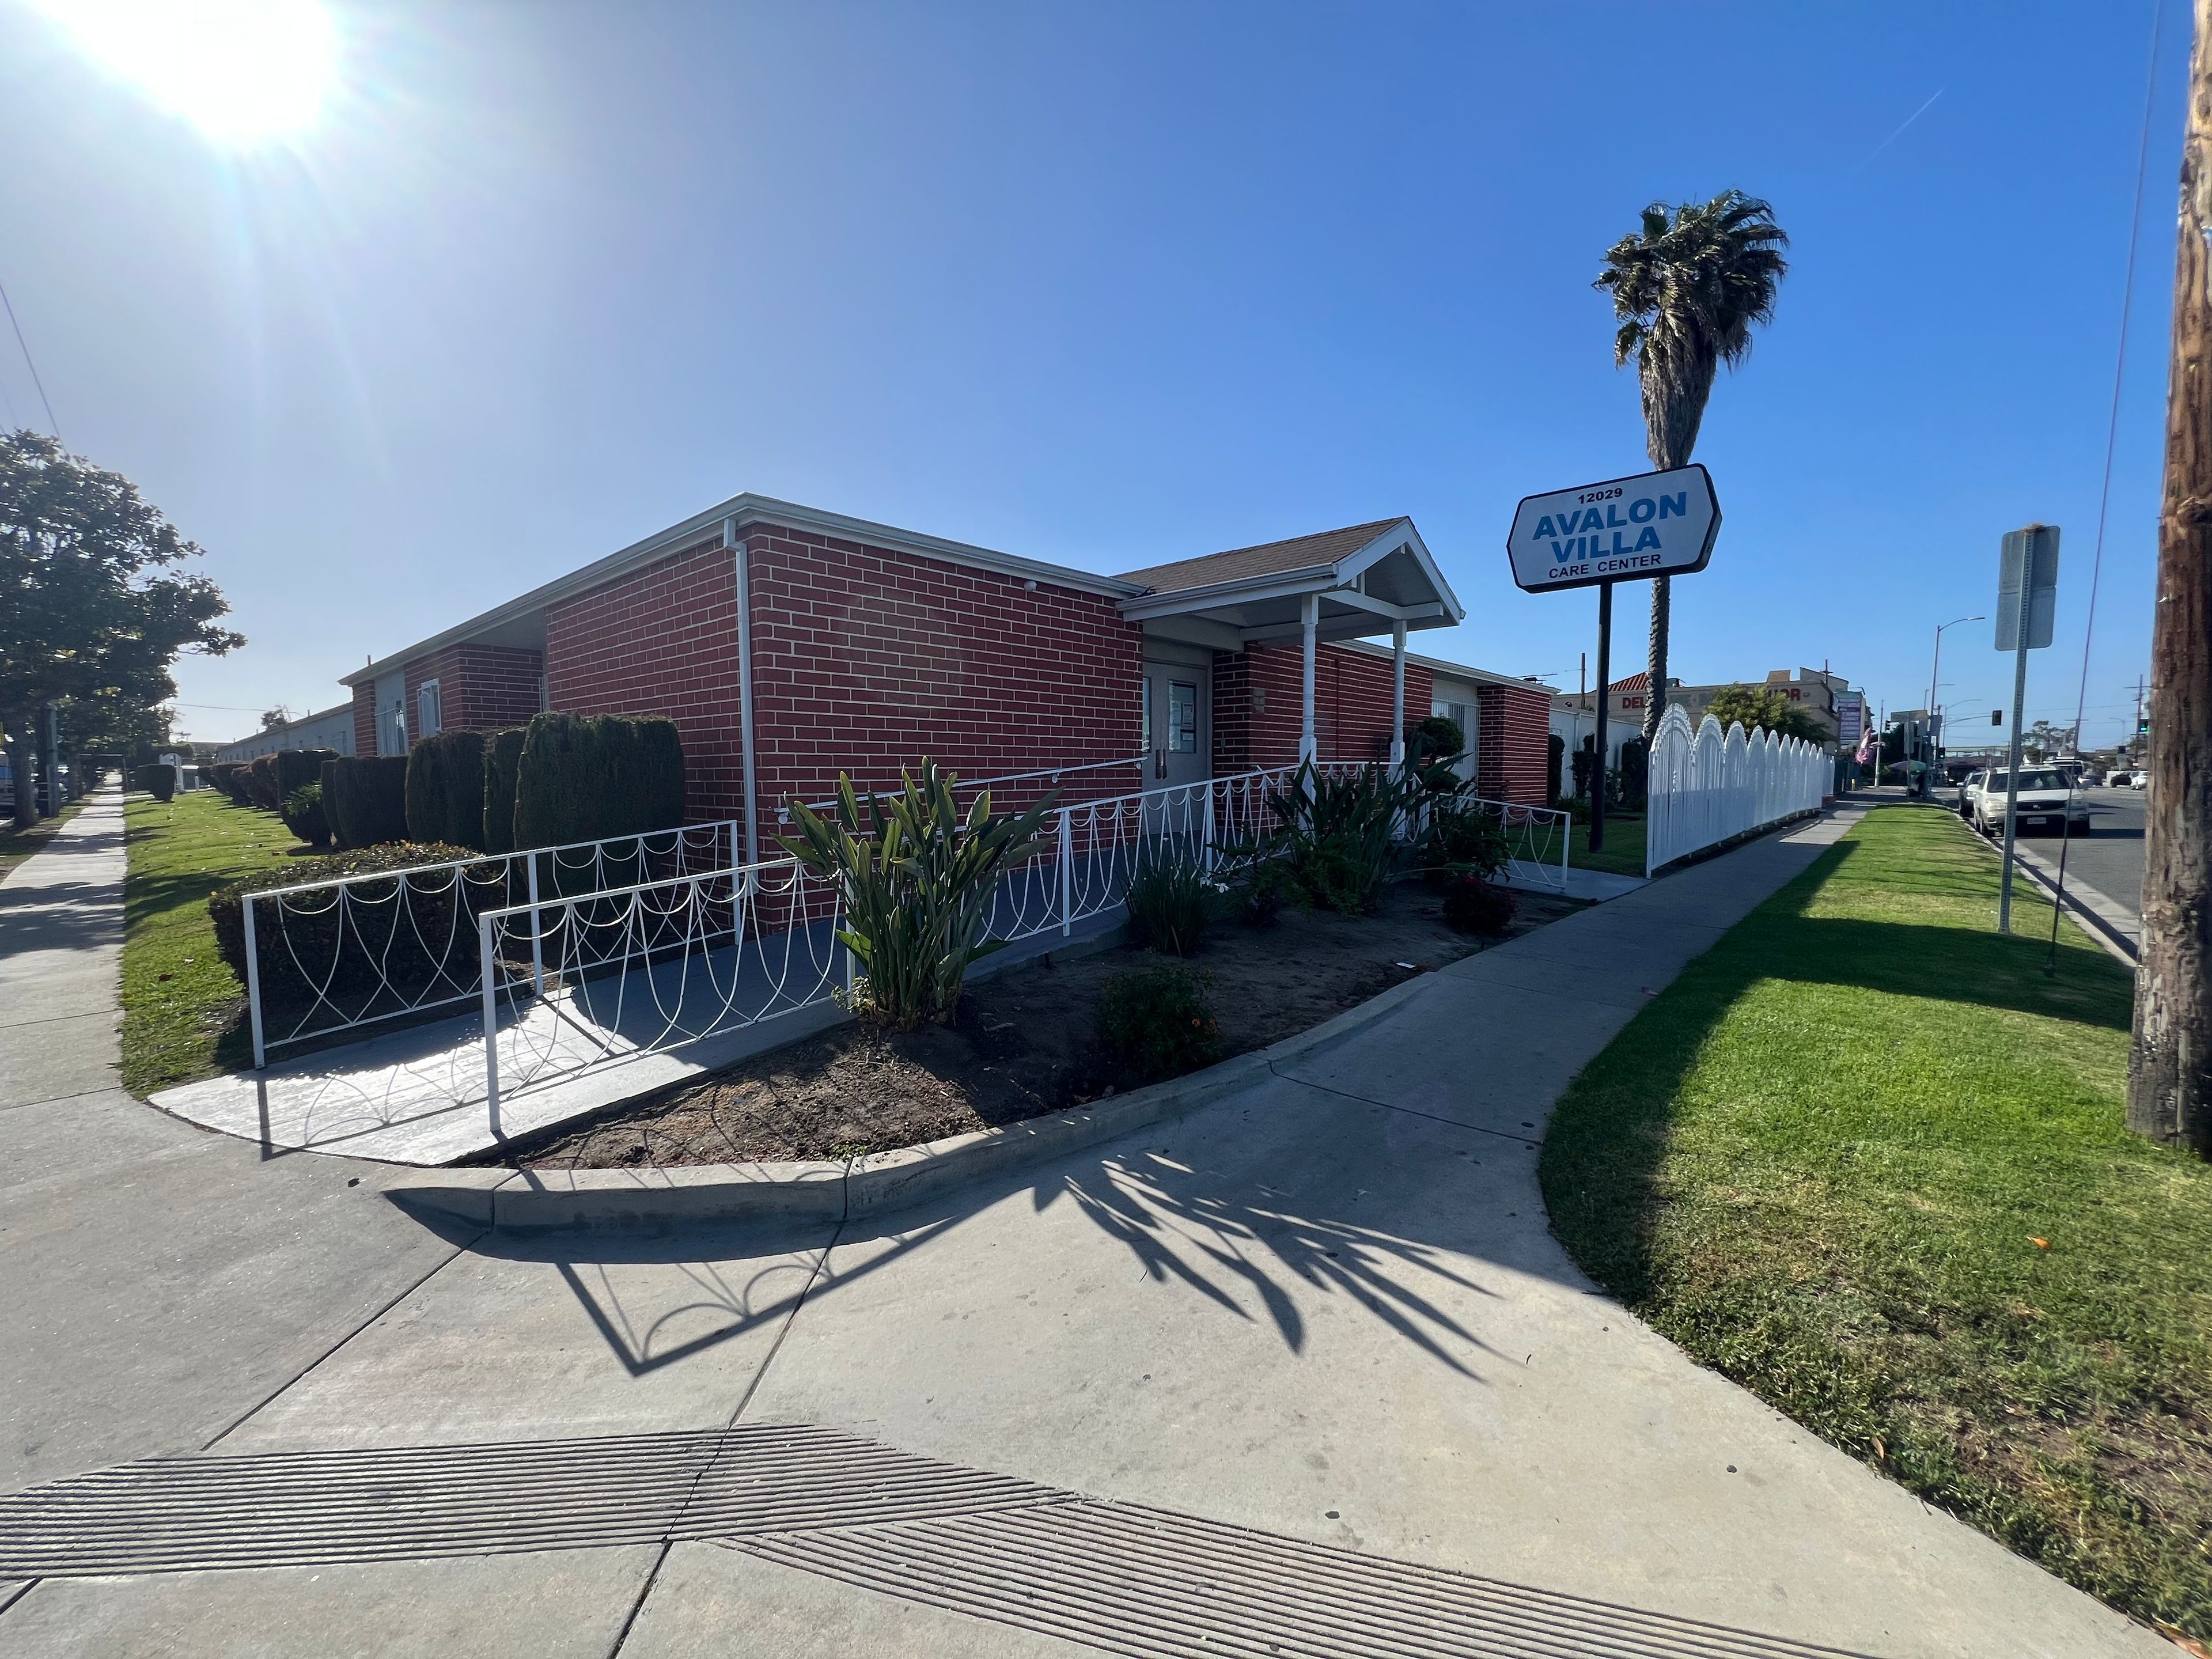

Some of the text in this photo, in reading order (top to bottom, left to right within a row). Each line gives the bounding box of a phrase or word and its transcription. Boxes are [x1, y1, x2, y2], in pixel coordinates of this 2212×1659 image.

[1578, 488, 1623, 504] 12029
[1533, 491, 1687, 540] AVALON
[1551, 527, 1661, 563] VILLA
[1549, 554, 1661, 578] CARE CENTER
